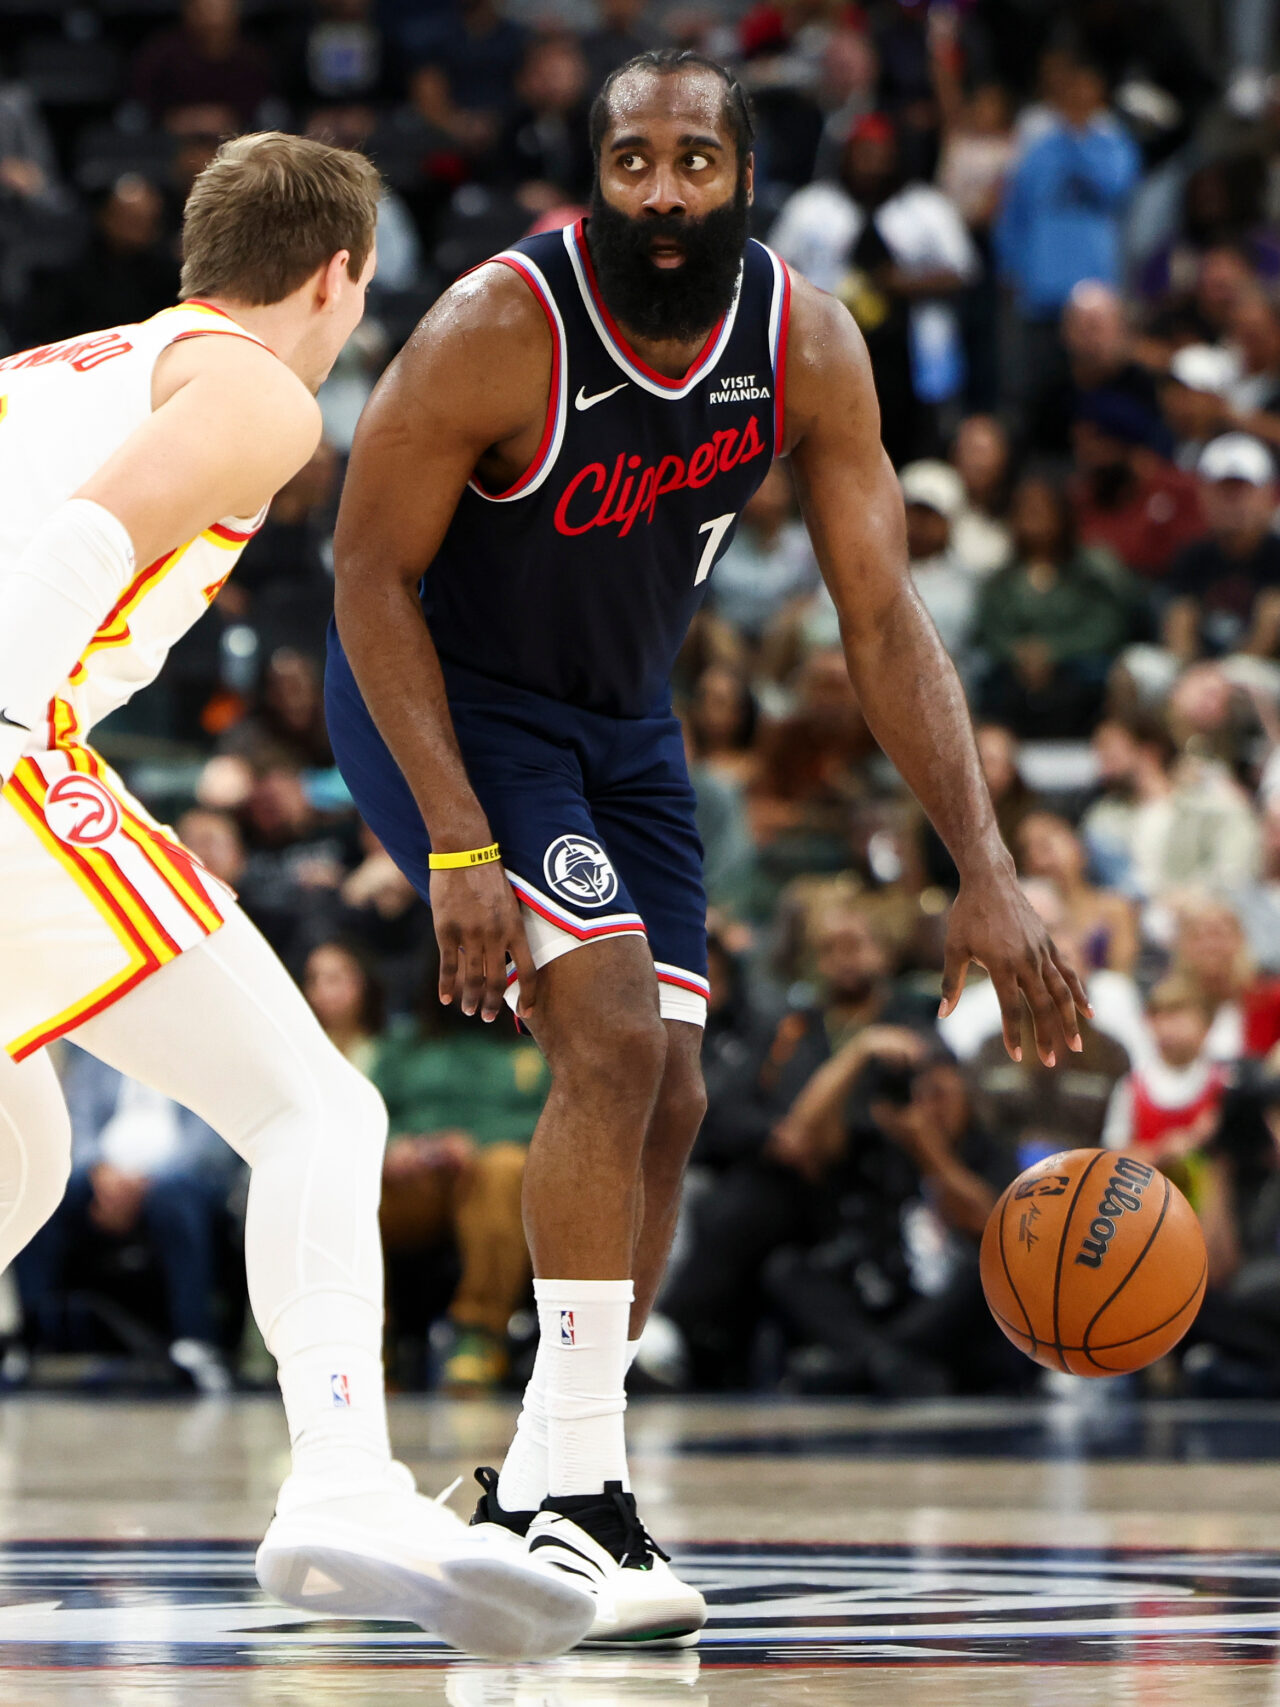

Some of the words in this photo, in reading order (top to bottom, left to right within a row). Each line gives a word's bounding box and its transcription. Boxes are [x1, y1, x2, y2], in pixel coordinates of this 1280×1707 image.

[709, 387, 771, 404] RWANDA
[720, 375, 756, 389] VISIT
[553, 415, 766, 538] Clippers
[1075, 1157, 1155, 1269] Wilson
